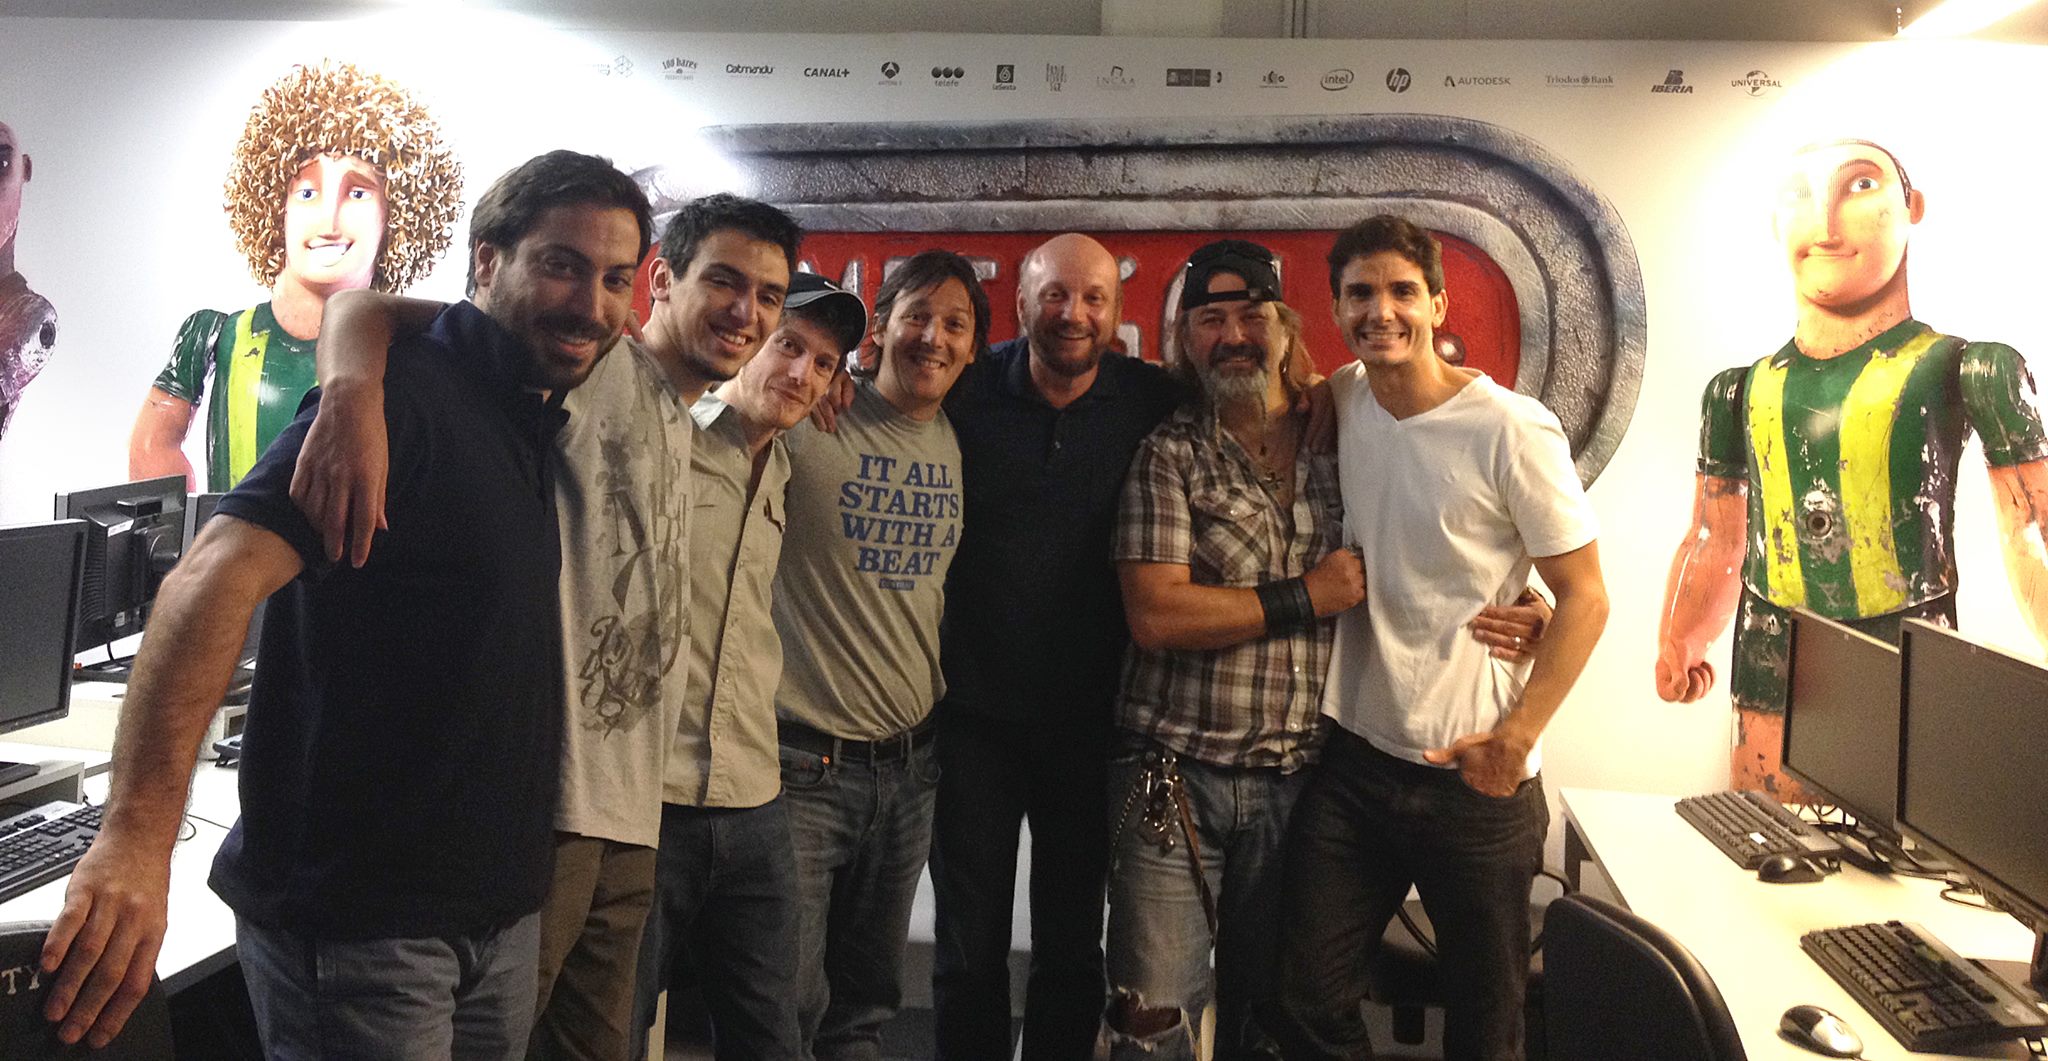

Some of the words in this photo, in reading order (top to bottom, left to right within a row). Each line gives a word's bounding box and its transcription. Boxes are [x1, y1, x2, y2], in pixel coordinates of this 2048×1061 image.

[726, 64, 773, 74] Catmandu
[803, 67, 850, 77] CANAL+
[1387, 68, 1411, 93] hp
[1457, 76, 1511, 86] AUTODESK
[1591, 75, 1614, 84] Bank
[1731, 79, 1783, 88] UNIVERSAL
[1651, 85, 1693, 94] IBERIA
[857, 453, 896, 483] IT
[903, 461, 953, 488] ALL
[839, 481, 959, 518] STARTS
[841, 512, 936, 547] WITH
[941, 523, 956, 547] A
[855, 546, 941, 575] BEAT
